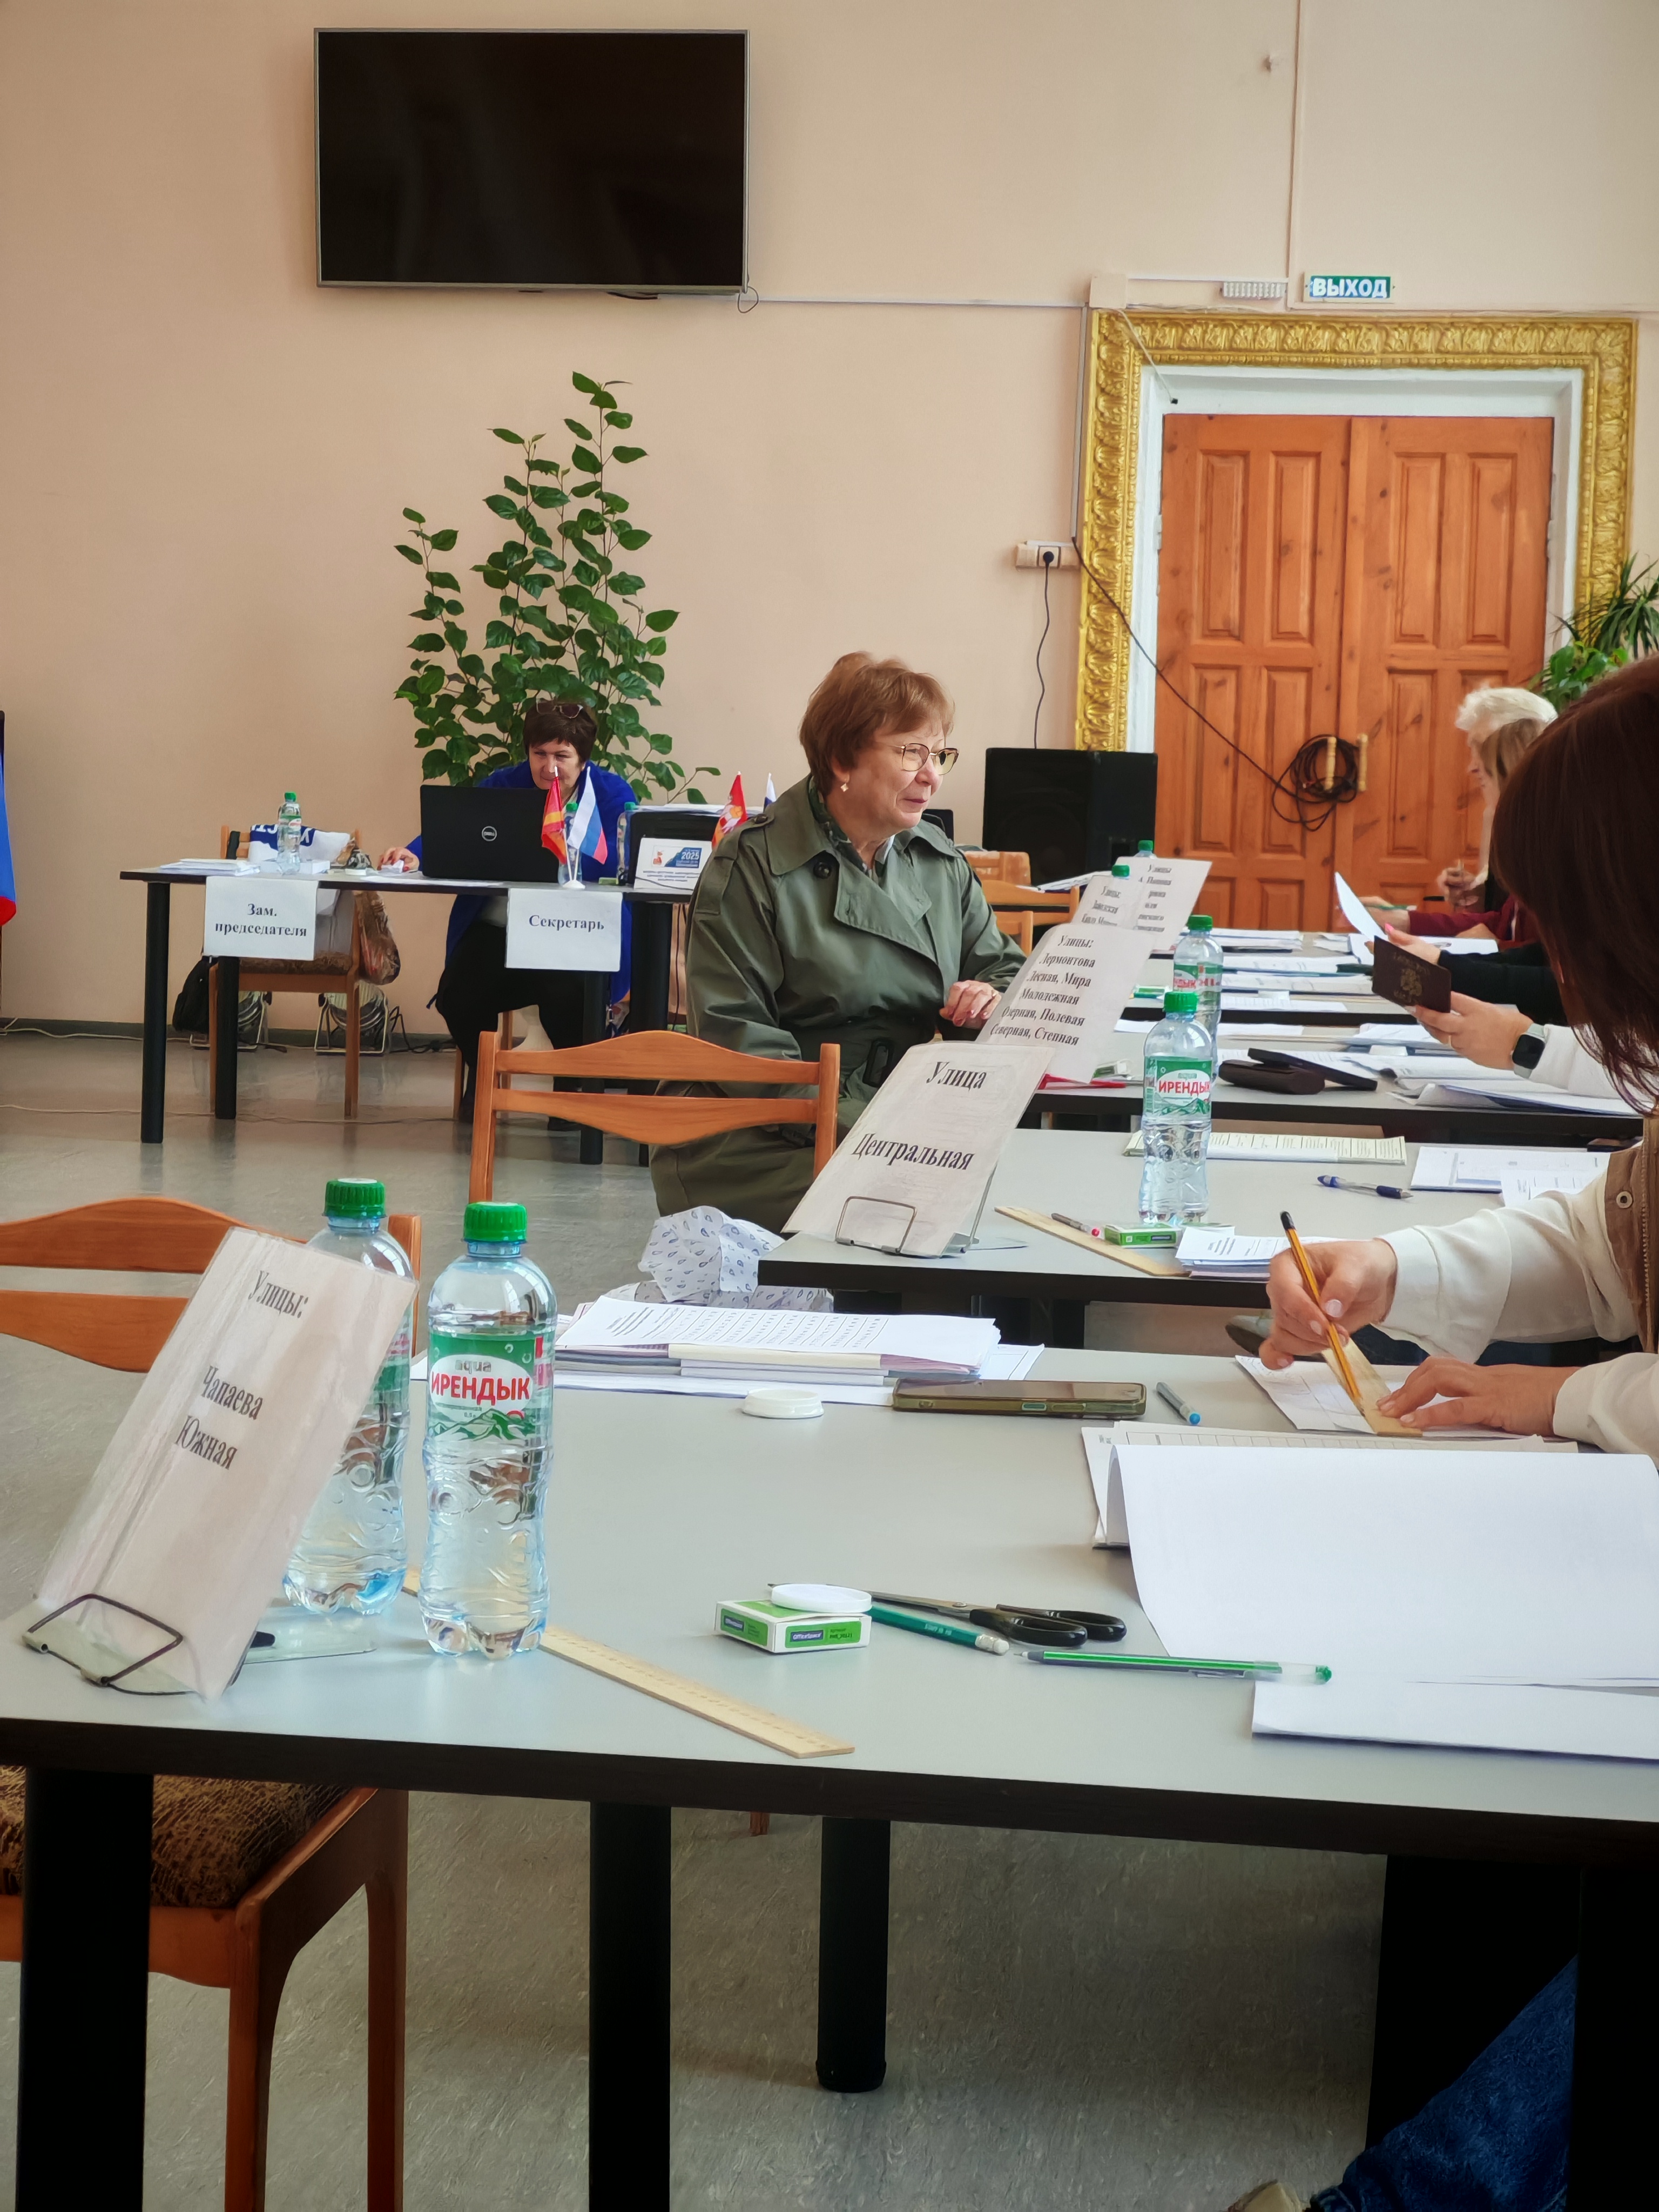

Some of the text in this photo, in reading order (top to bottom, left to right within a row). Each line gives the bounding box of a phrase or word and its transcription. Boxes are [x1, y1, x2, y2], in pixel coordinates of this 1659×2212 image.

[1312, 278, 1387, 298] ВЫХОД
[681, 852, 700, 860] 2025
[247, 903, 276, 916] Зам.
[215, 923, 307, 937] председателя
[529, 915, 604, 933] Секретарь
[1058, 935, 1094, 948] Улицы:
[1039, 953, 1096, 968] Лермонтова
[1026, 970, 1091, 989] Лесная, Мира
[1019, 988, 1080, 1005] Молодежная
[1001, 1006, 1085, 1027] Озерная, Полевая
[990, 1023, 1080, 1046] Северная, Степная
[926, 1061, 987, 1091] Улица
[851, 1133, 975, 1170] Центральная
[248, 1270, 309, 1319] Улицы:
[200, 1365, 264, 1420] Чапаева
[431, 1371, 530, 1406] ИРЕНДЫК
[174, 1415, 238, 1470] Южная
